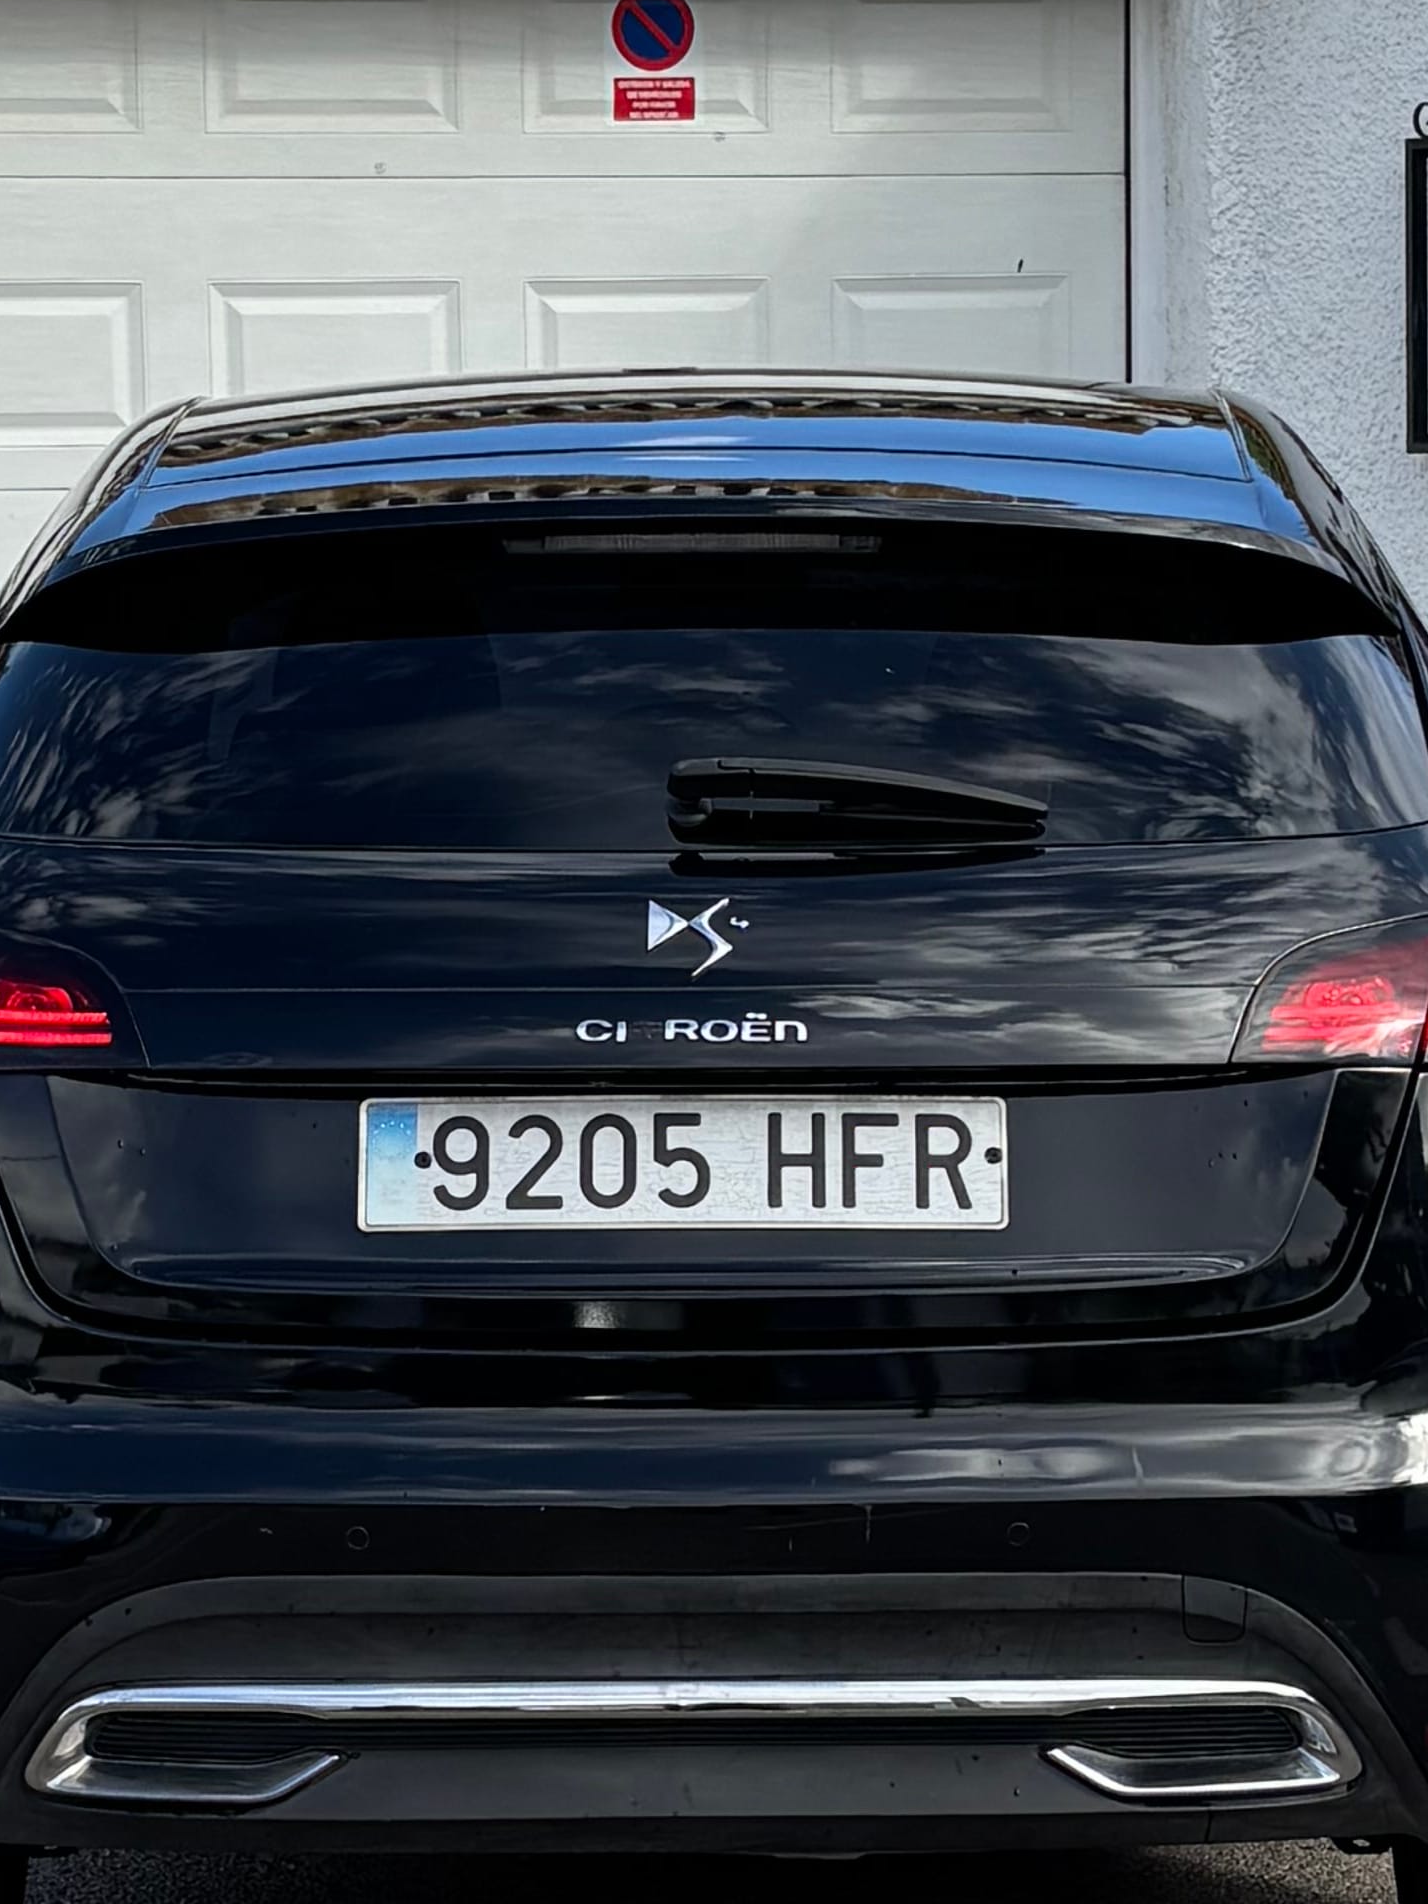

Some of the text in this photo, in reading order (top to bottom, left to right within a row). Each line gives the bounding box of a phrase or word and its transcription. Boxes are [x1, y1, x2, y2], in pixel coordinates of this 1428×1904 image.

[575, 1011, 809, 1043] CIROËN
[432, 1112, 973, 1212] 9205 HFR
